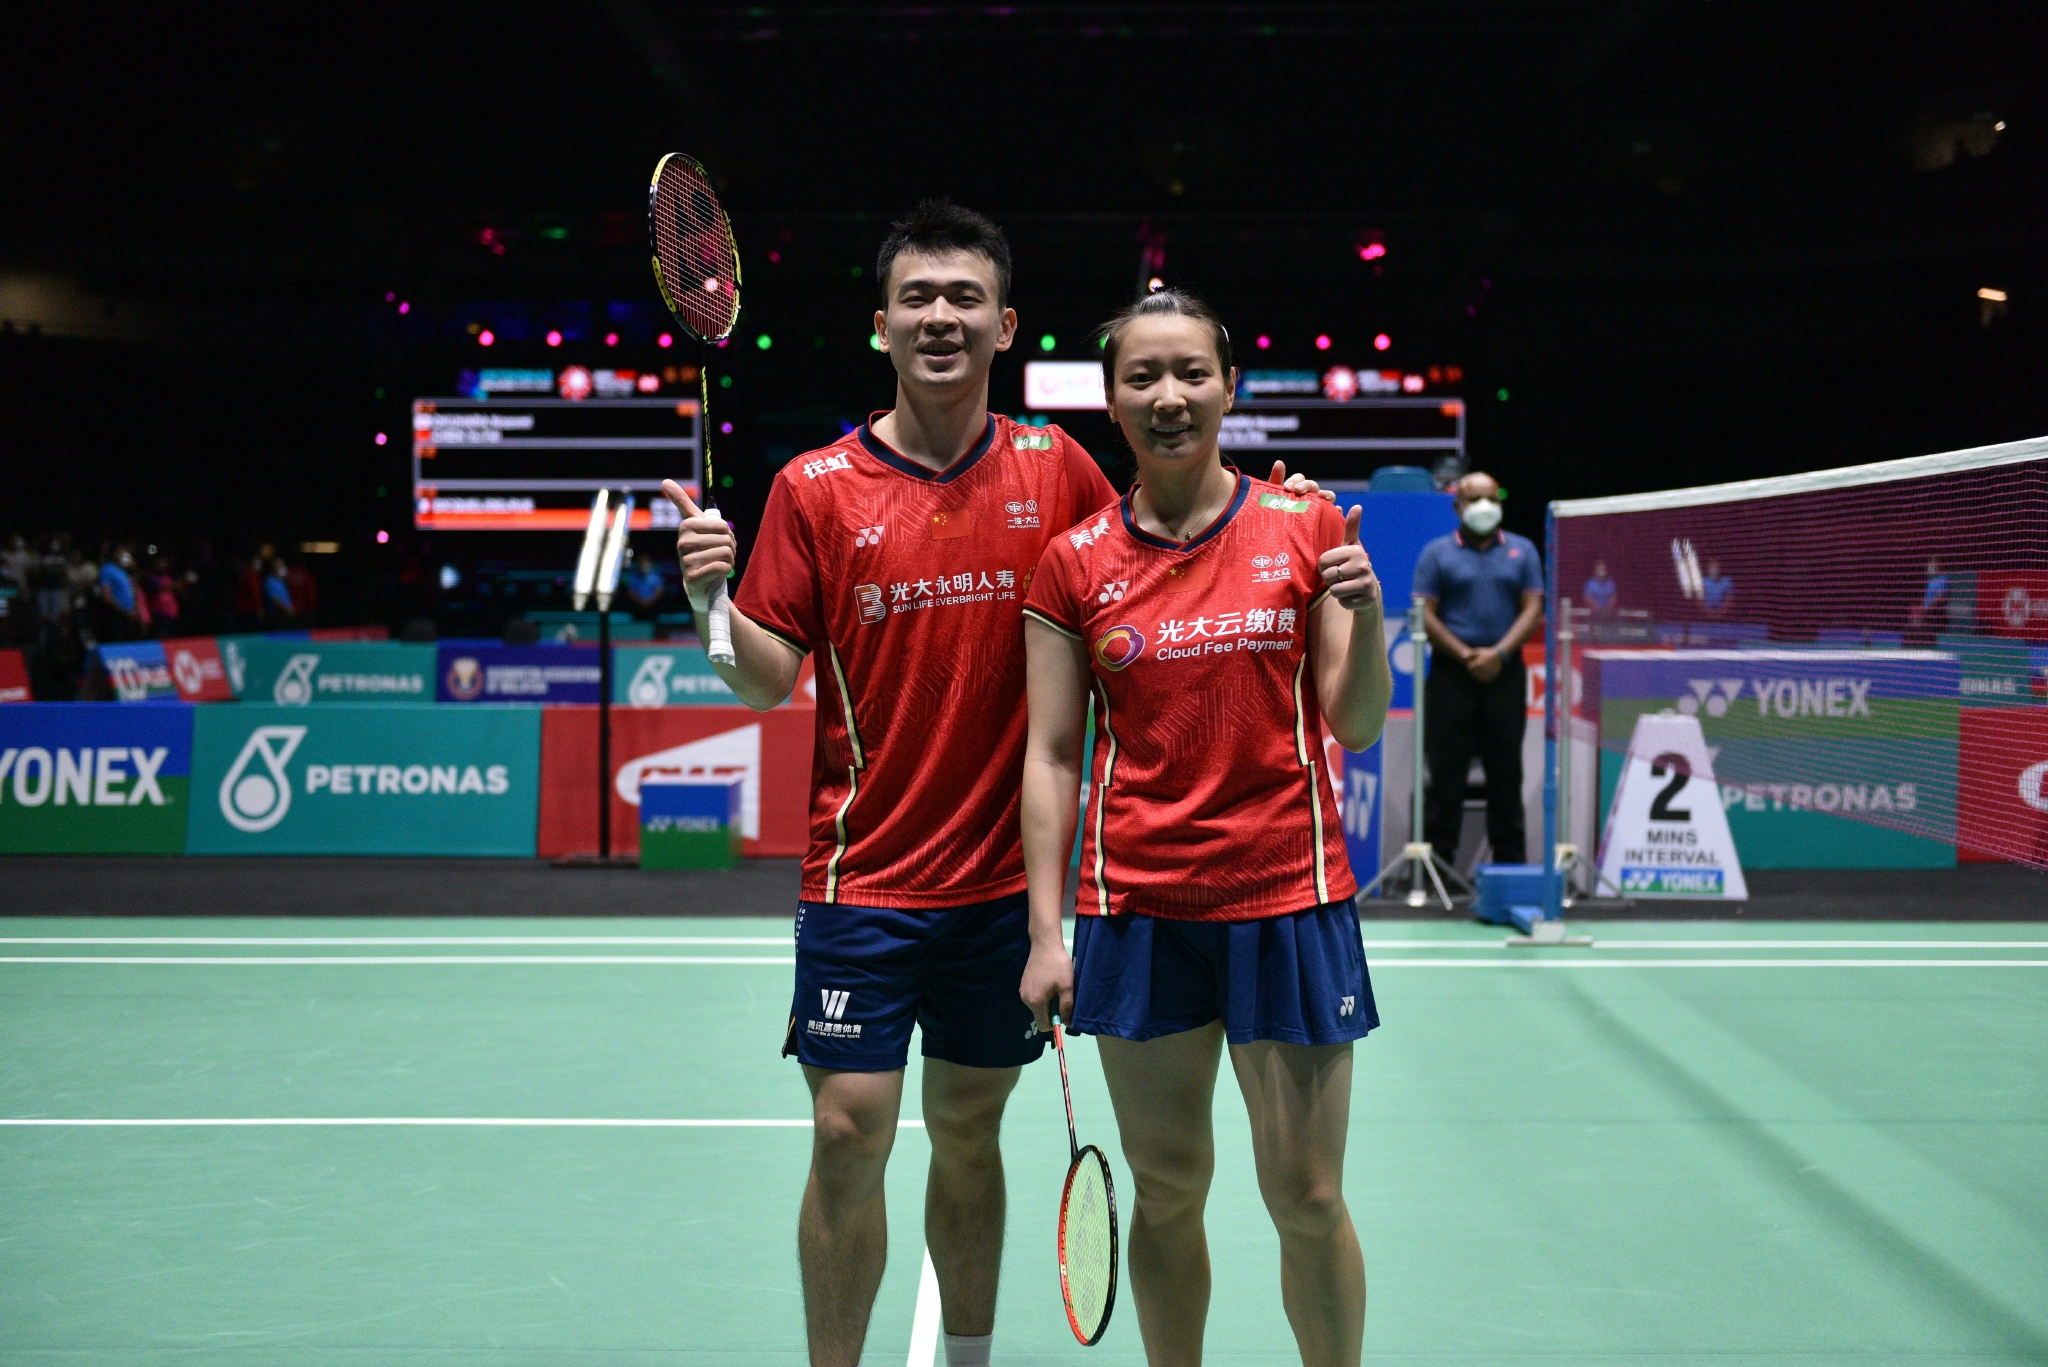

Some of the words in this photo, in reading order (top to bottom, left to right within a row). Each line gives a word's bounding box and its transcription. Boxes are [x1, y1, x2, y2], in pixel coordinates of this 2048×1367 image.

[890, 569, 1016, 603] 光大永明人寿
[893, 603, 912, 614] SUN
[913, 599, 934, 610] LIFE
[935, 592, 994, 607] EVERBRIGHT
[996, 590, 1016, 600] LIFE
[1156, 607, 1297, 645] 光大云缴费
[1156, 644, 1200, 661] Cloud
[1204, 641, 1233, 655] Fee
[1236, 637, 1294, 653] Payment
[318, 673, 422, 693] PETRONAS
[1753, 678, 1872, 718] YONEX
[306, 764, 509, 795] PETRONAS
[1649, 752, 1693, 822] 2
[1722, 782, 1917, 811] PETRONAS
[1647, 830, 1698, 845] MINS
[1625, 850, 1719, 864] INTERVAL
[1661, 872, 1718, 891] YONEX
